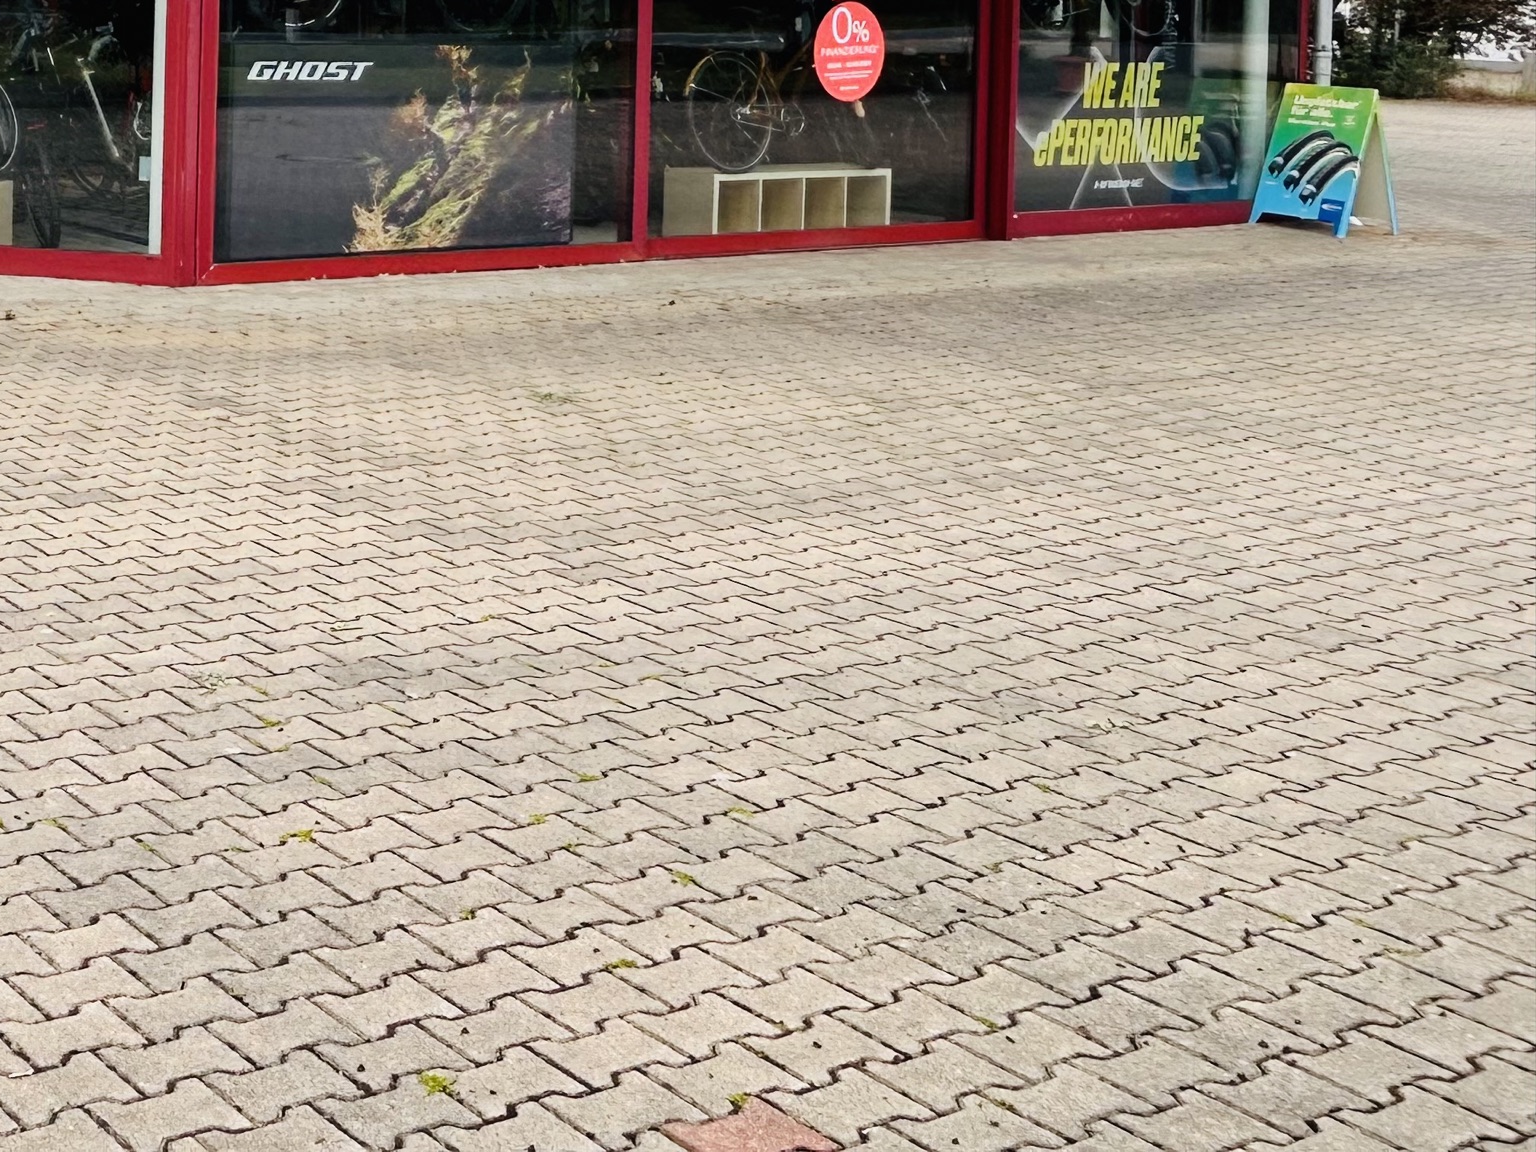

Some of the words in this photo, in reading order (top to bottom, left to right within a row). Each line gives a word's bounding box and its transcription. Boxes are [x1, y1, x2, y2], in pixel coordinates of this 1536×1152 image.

[832, 6, 870, 44] 0%
[247, 61, 374, 81] GHOST
[1082, 62, 1120, 109] WE
[1119, 62, 1165, 108] ARE
[1033, 115, 1205, 167] ePERFORMANCE
